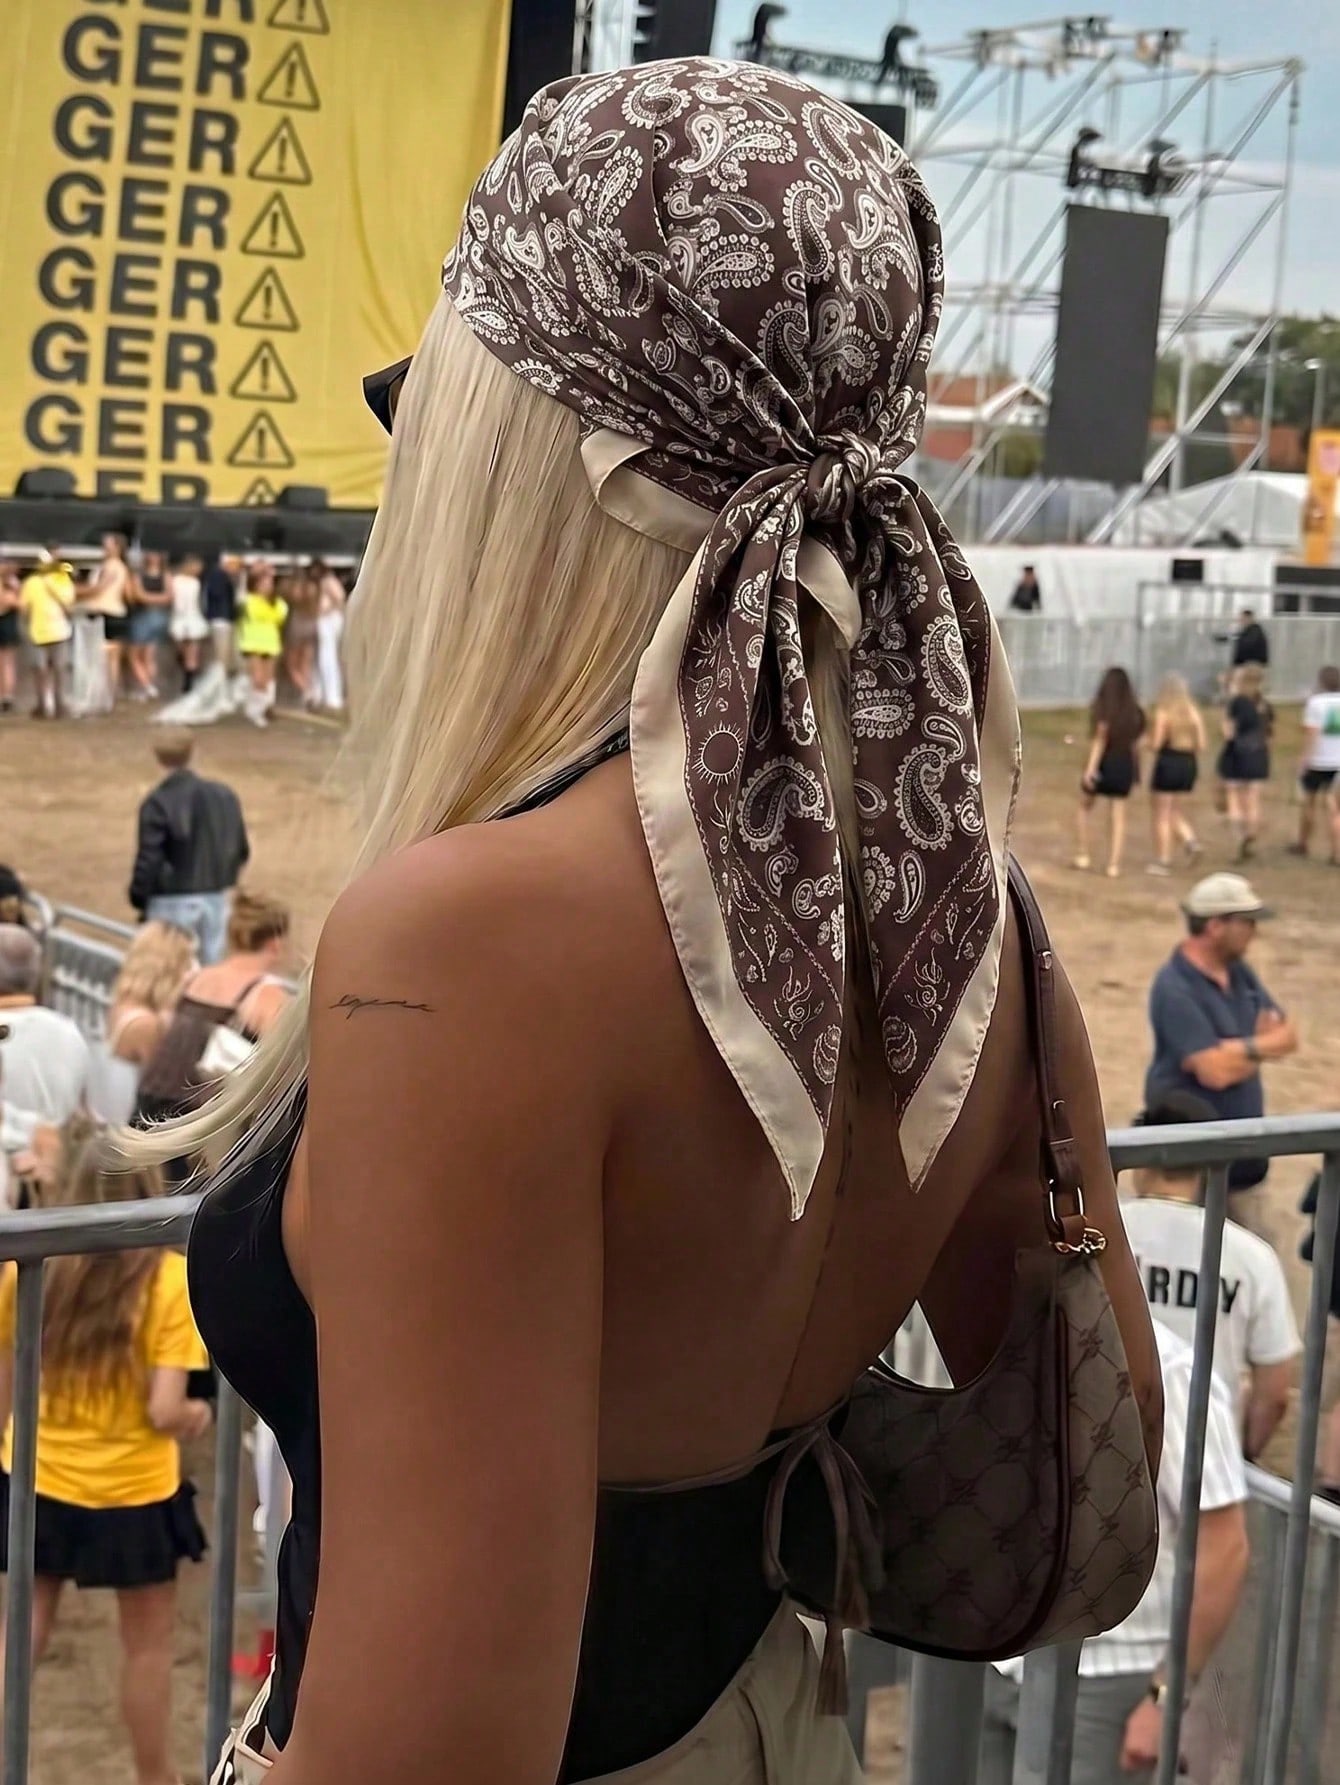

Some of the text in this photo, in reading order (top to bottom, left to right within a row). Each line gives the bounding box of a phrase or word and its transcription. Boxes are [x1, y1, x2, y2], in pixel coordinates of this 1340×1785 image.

[62, 13, 250, 101] GER
[53, 93, 239, 175] GER
[45, 171, 230, 250] GER
[38, 246, 222, 323] GER
[31, 321, 217, 395] GER
[24, 394, 212, 464] GER
